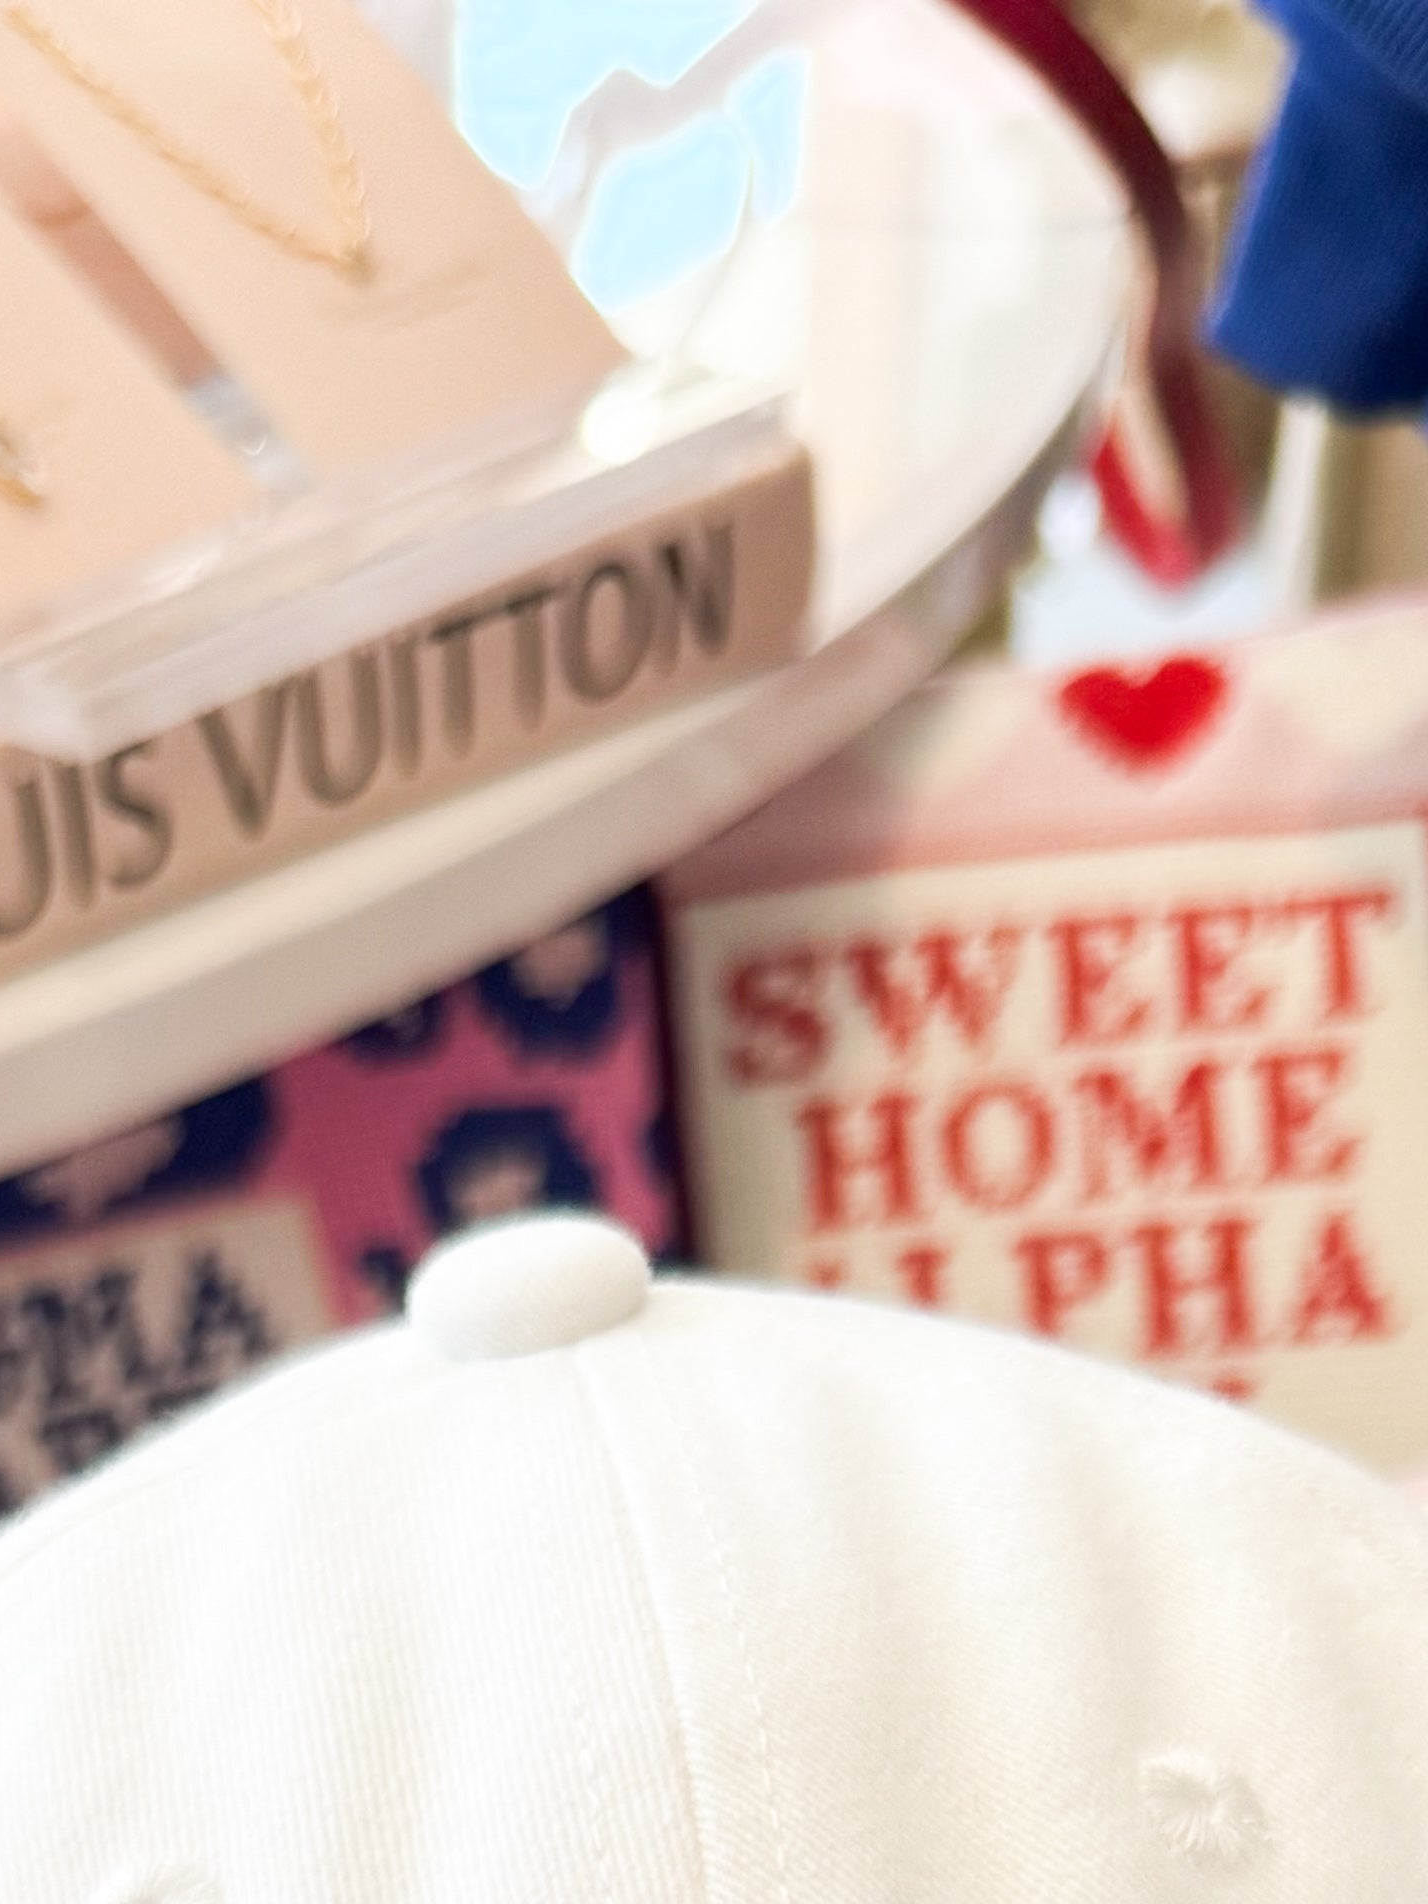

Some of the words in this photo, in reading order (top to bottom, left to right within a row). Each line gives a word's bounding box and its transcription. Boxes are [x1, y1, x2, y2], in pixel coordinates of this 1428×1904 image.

[196, 520, 738, 842] VUITTON
[720, 889, 1396, 1088] SWEET
[794, 1049, 1365, 1234] HOME
[805, 1212, 1396, 1359] PHA
